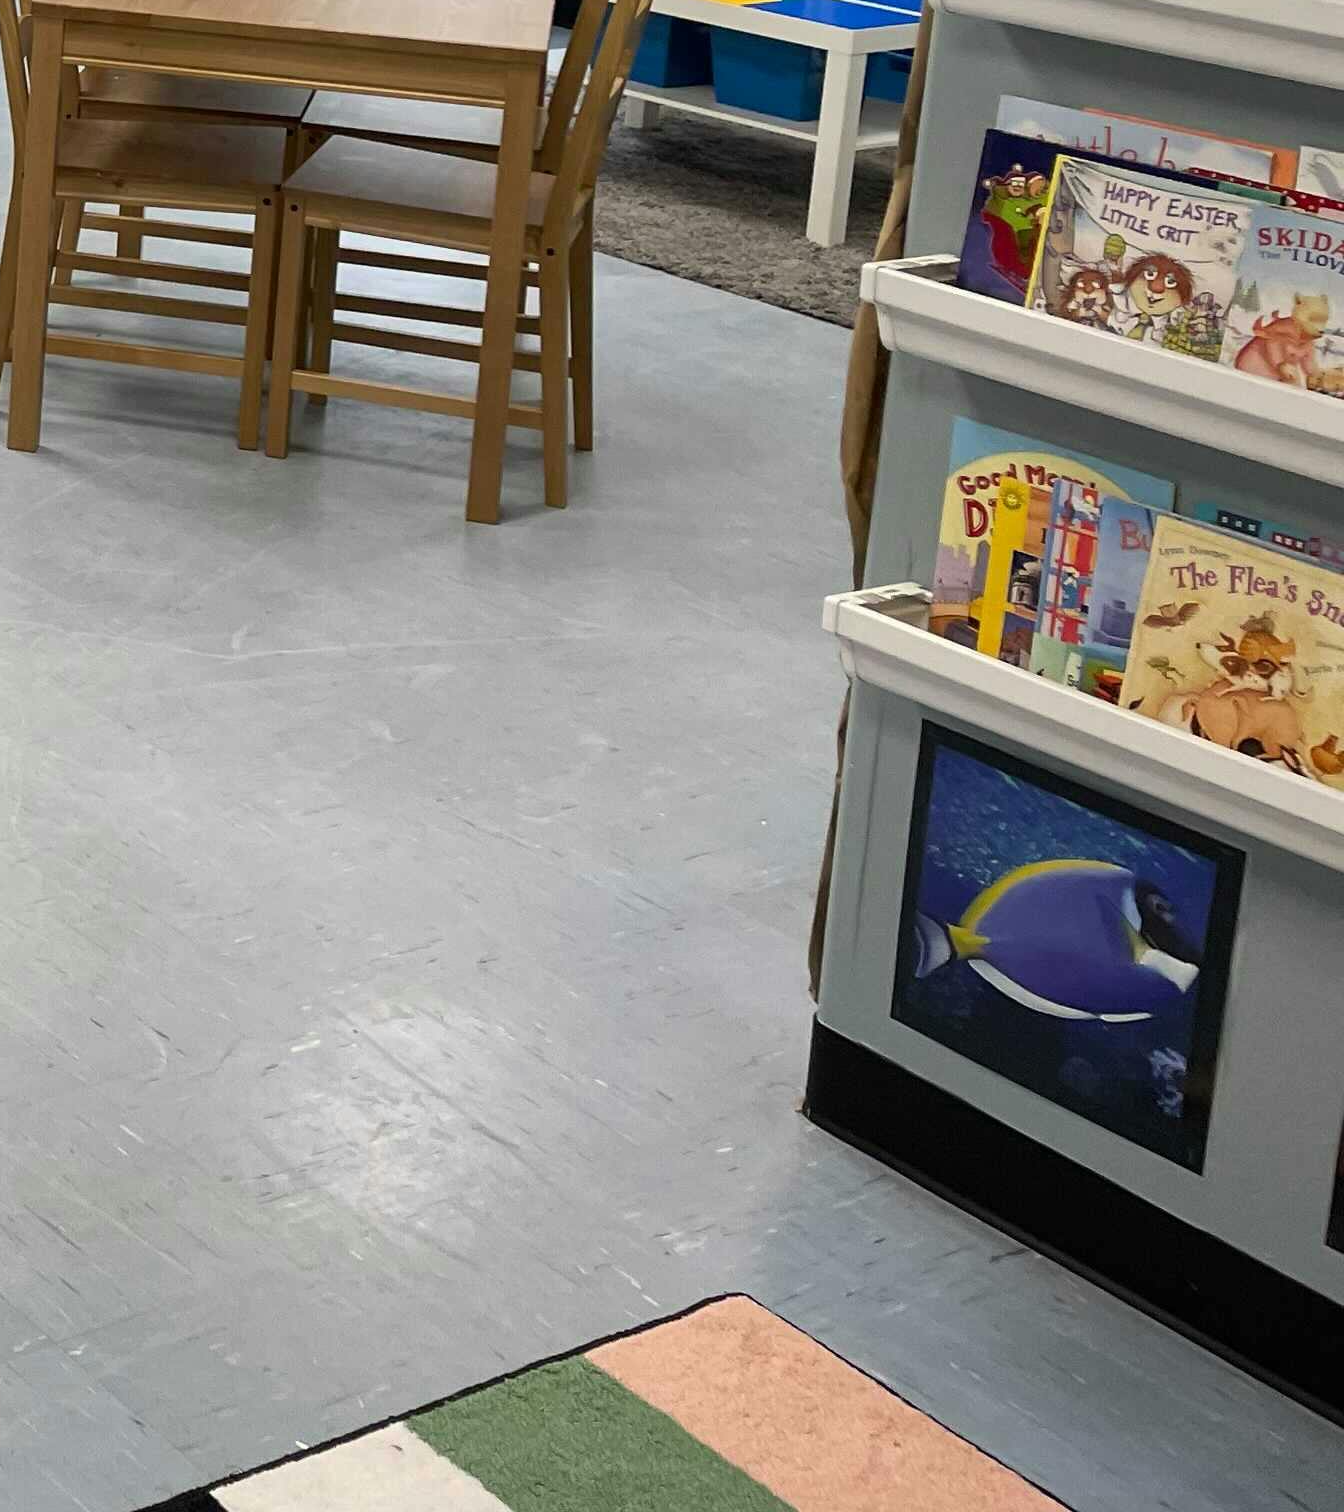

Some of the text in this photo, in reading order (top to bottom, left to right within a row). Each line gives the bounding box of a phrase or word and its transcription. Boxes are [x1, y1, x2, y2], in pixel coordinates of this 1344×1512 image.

[1100, 204, 1200, 245] LITTLE CRIT
[1104, 181, 1241, 232] HAPPY EASTER,
[957, 463, 1018, 496] Good
[1170, 562, 1218, 590] The
[1226, 565, 1298, 603] Flea's
